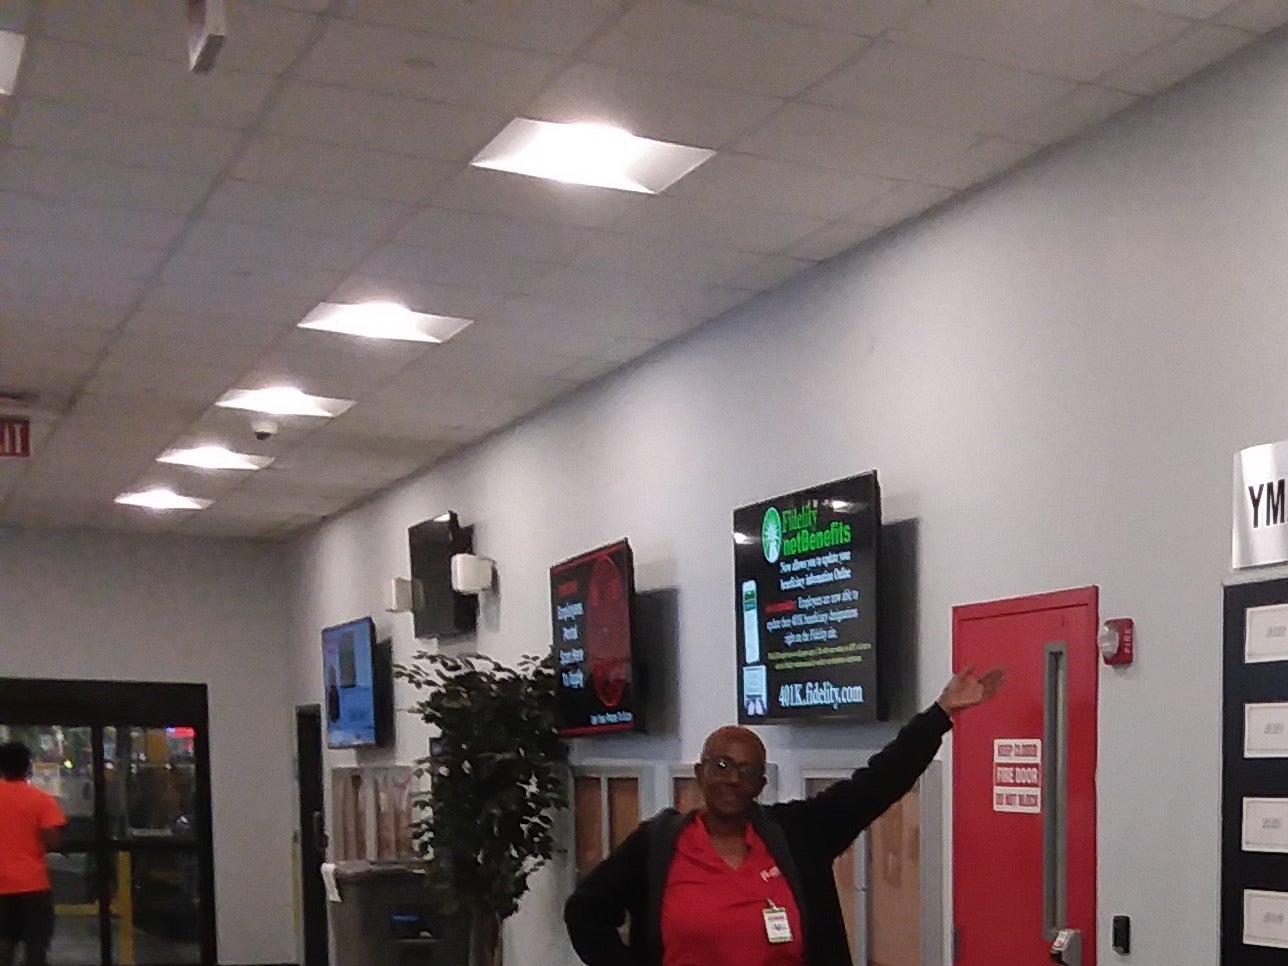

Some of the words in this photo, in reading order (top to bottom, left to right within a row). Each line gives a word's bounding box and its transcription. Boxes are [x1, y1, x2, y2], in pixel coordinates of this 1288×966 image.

[782, 504, 817, 532] Fidelity
[779, 681, 865, 709] 401K.fidelity.com
[1015, 766, 1039, 785] DOOR
